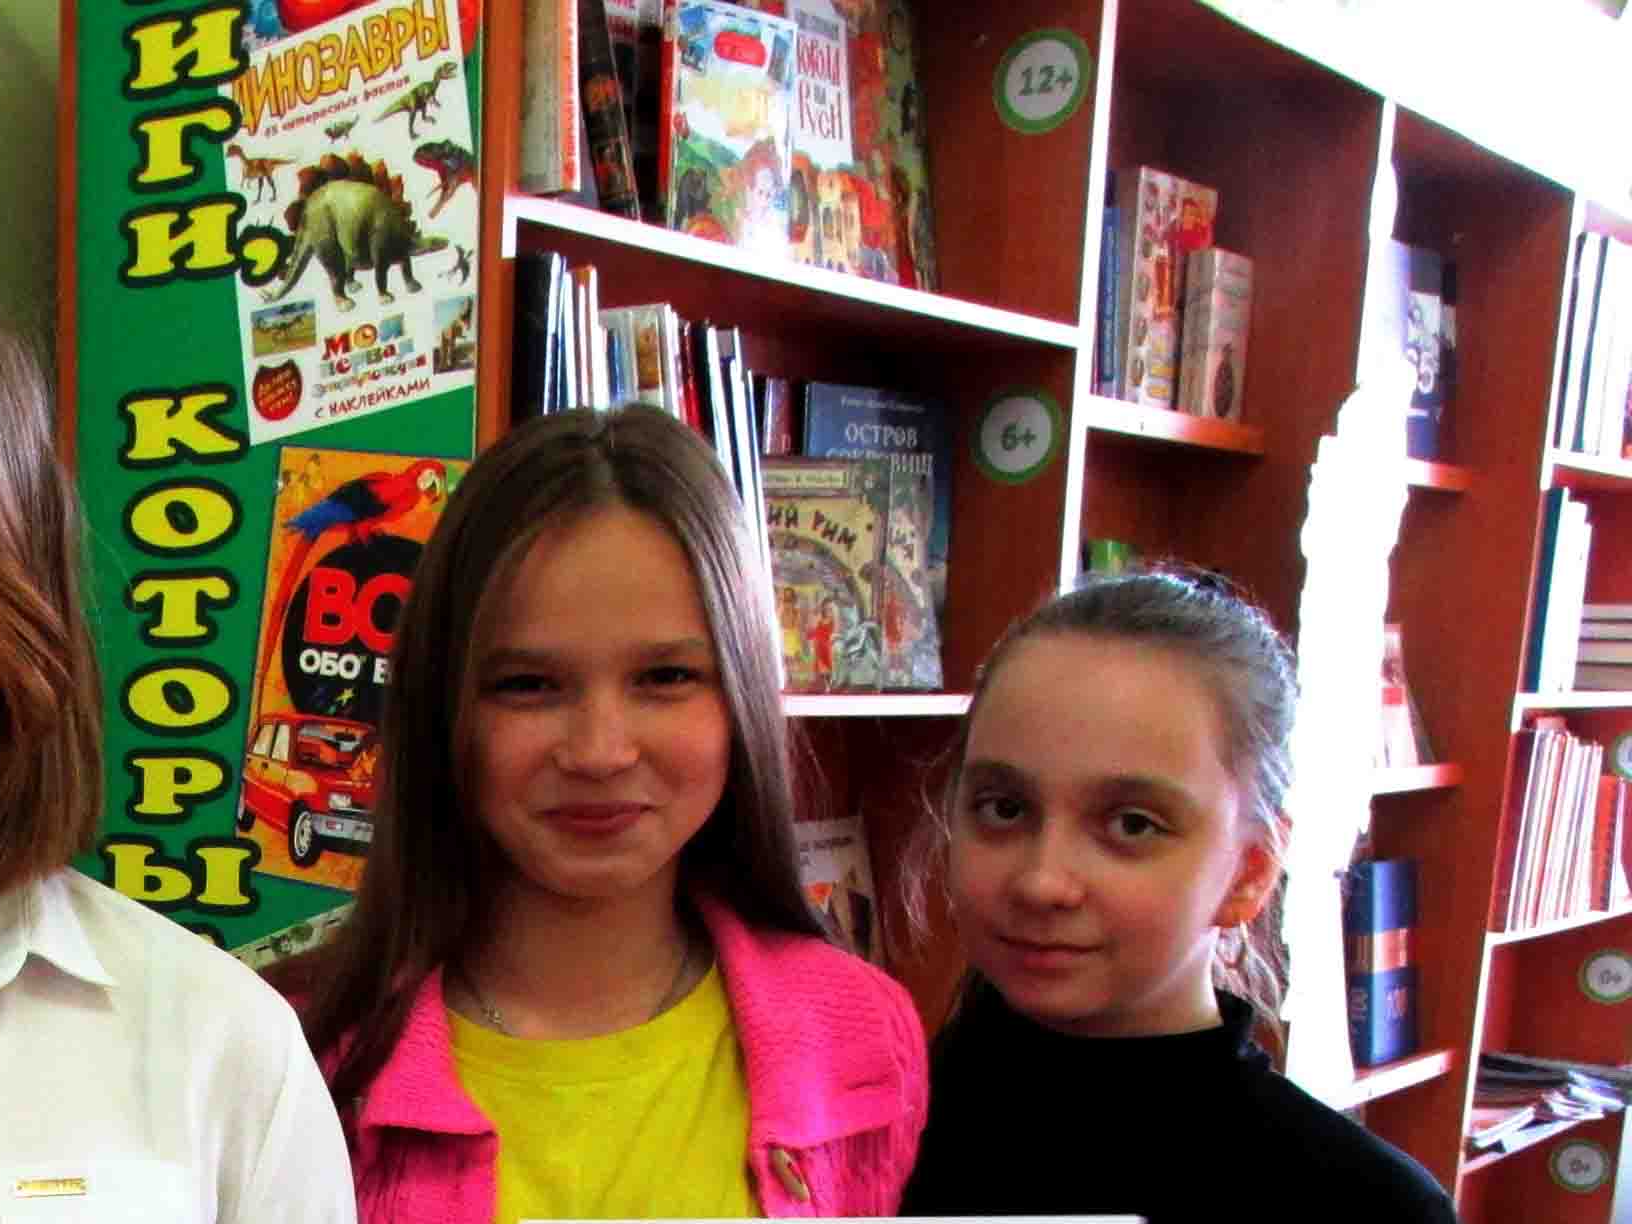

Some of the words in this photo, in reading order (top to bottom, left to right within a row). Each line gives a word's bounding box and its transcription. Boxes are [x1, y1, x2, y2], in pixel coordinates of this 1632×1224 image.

[1018, 65, 1073, 96] 12+
[121, 0, 293, 288] ИГИ,
[844, 422, 918, 449] ОСТРОВ
[1000, 422, 1037, 452] 6+
[303, 566, 416, 654] ВС
[99, 382, 261, 948] КОТОРЫ
[299, 648, 362, 681] ОБО
